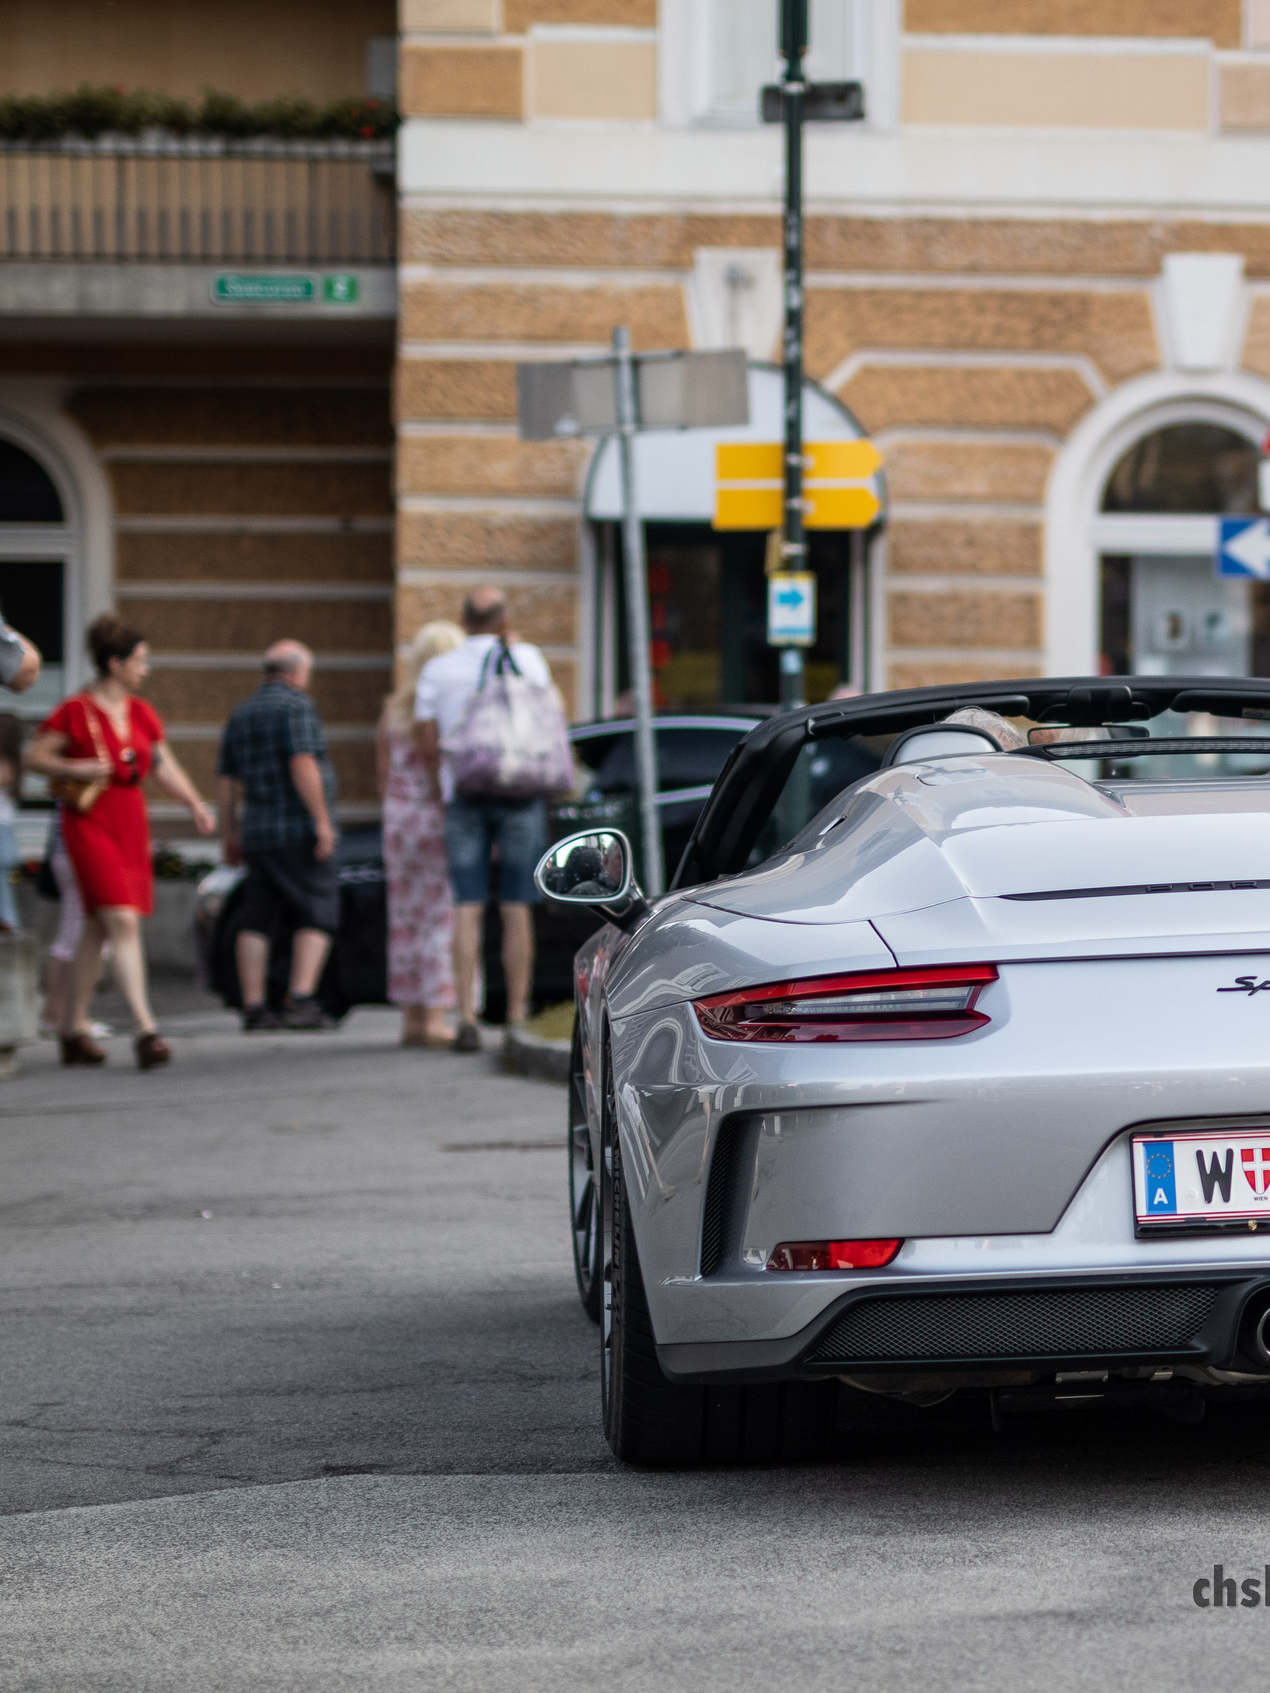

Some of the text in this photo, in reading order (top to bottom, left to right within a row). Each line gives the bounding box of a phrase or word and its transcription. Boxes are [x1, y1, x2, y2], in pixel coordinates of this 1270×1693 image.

[1153, 1188, 1168, 1205] A
[1195, 1148, 1235, 1203] W
[613, 1149, 621, 1269] MICHELIN
